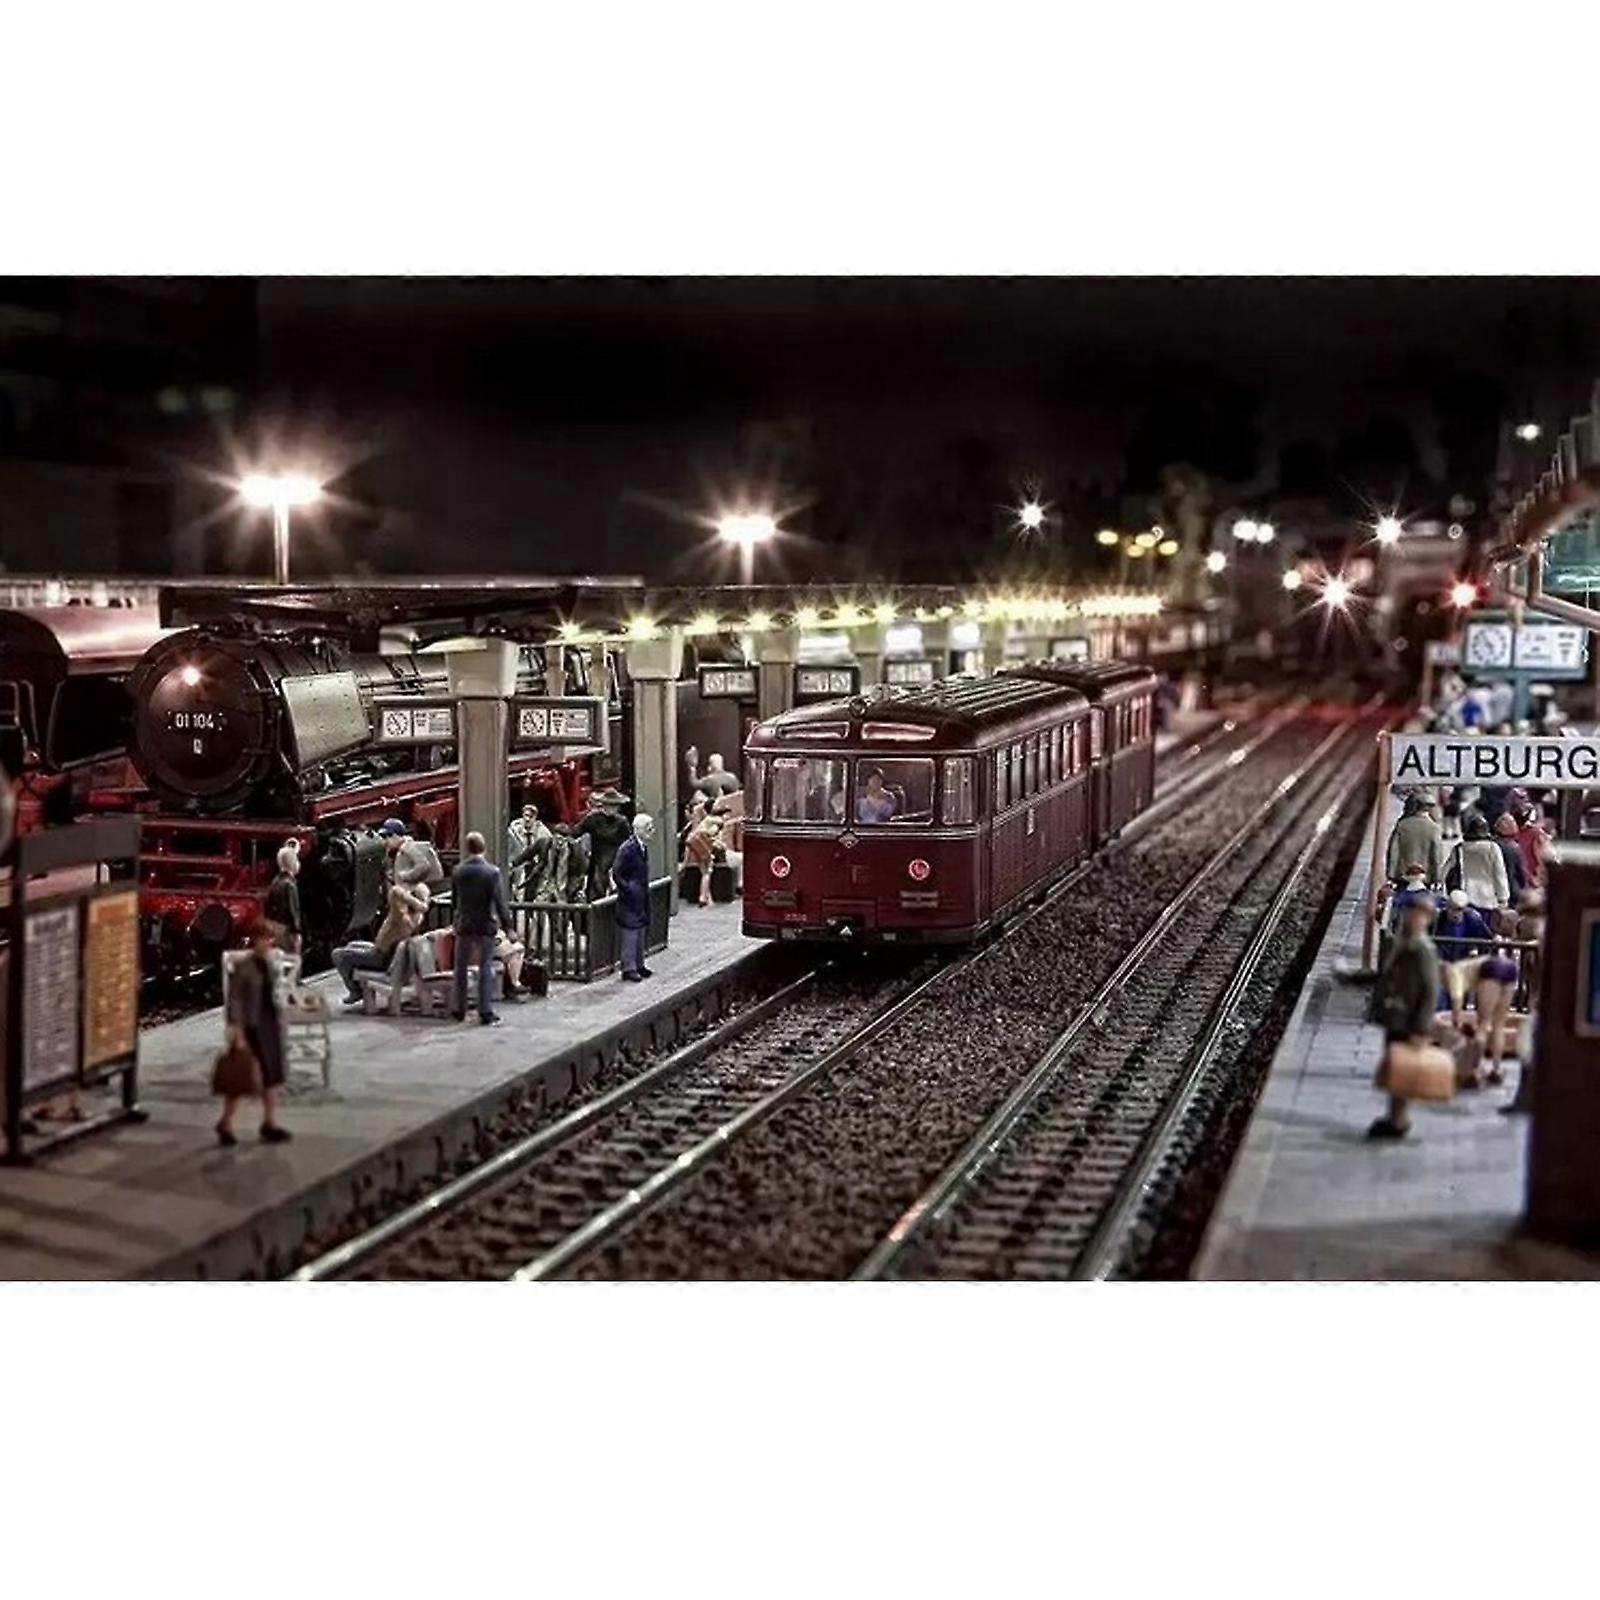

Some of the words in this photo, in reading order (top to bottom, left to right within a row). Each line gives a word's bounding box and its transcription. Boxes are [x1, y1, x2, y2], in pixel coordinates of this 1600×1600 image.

[176, 713, 189, 728] 01
[193, 713, 214, 729] 104
[1397, 744, 1598, 779] ALTBURG
